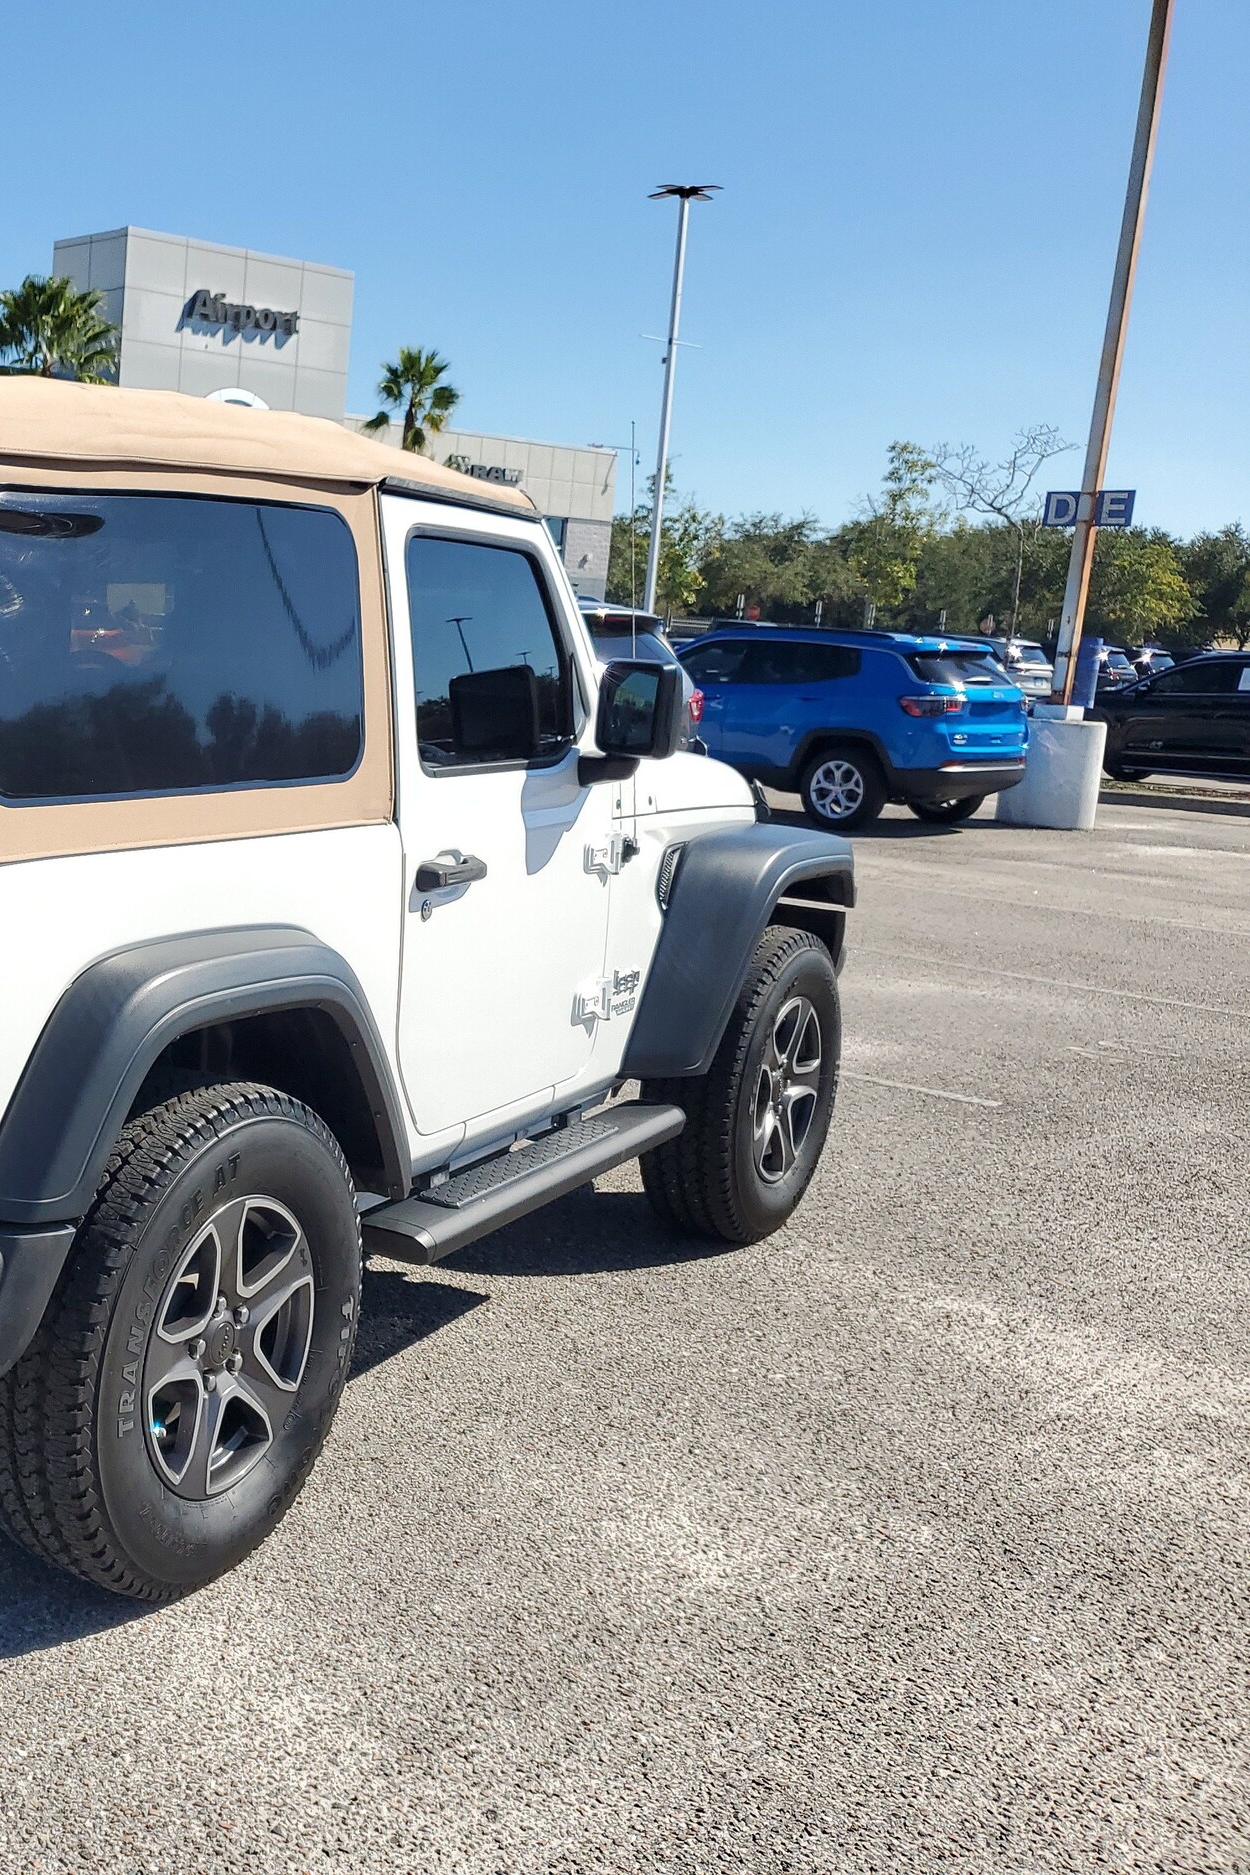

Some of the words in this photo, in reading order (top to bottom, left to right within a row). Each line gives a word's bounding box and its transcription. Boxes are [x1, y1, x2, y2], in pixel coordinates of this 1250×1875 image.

[190, 289, 300, 336] Airport
[471, 464, 524, 483] RAM
[1046, 493, 1077, 525] D
[1100, 492, 1129, 524] E
[118, 1188, 205, 1438] TRANSFORCE
[213, 1151, 241, 1198] AT
